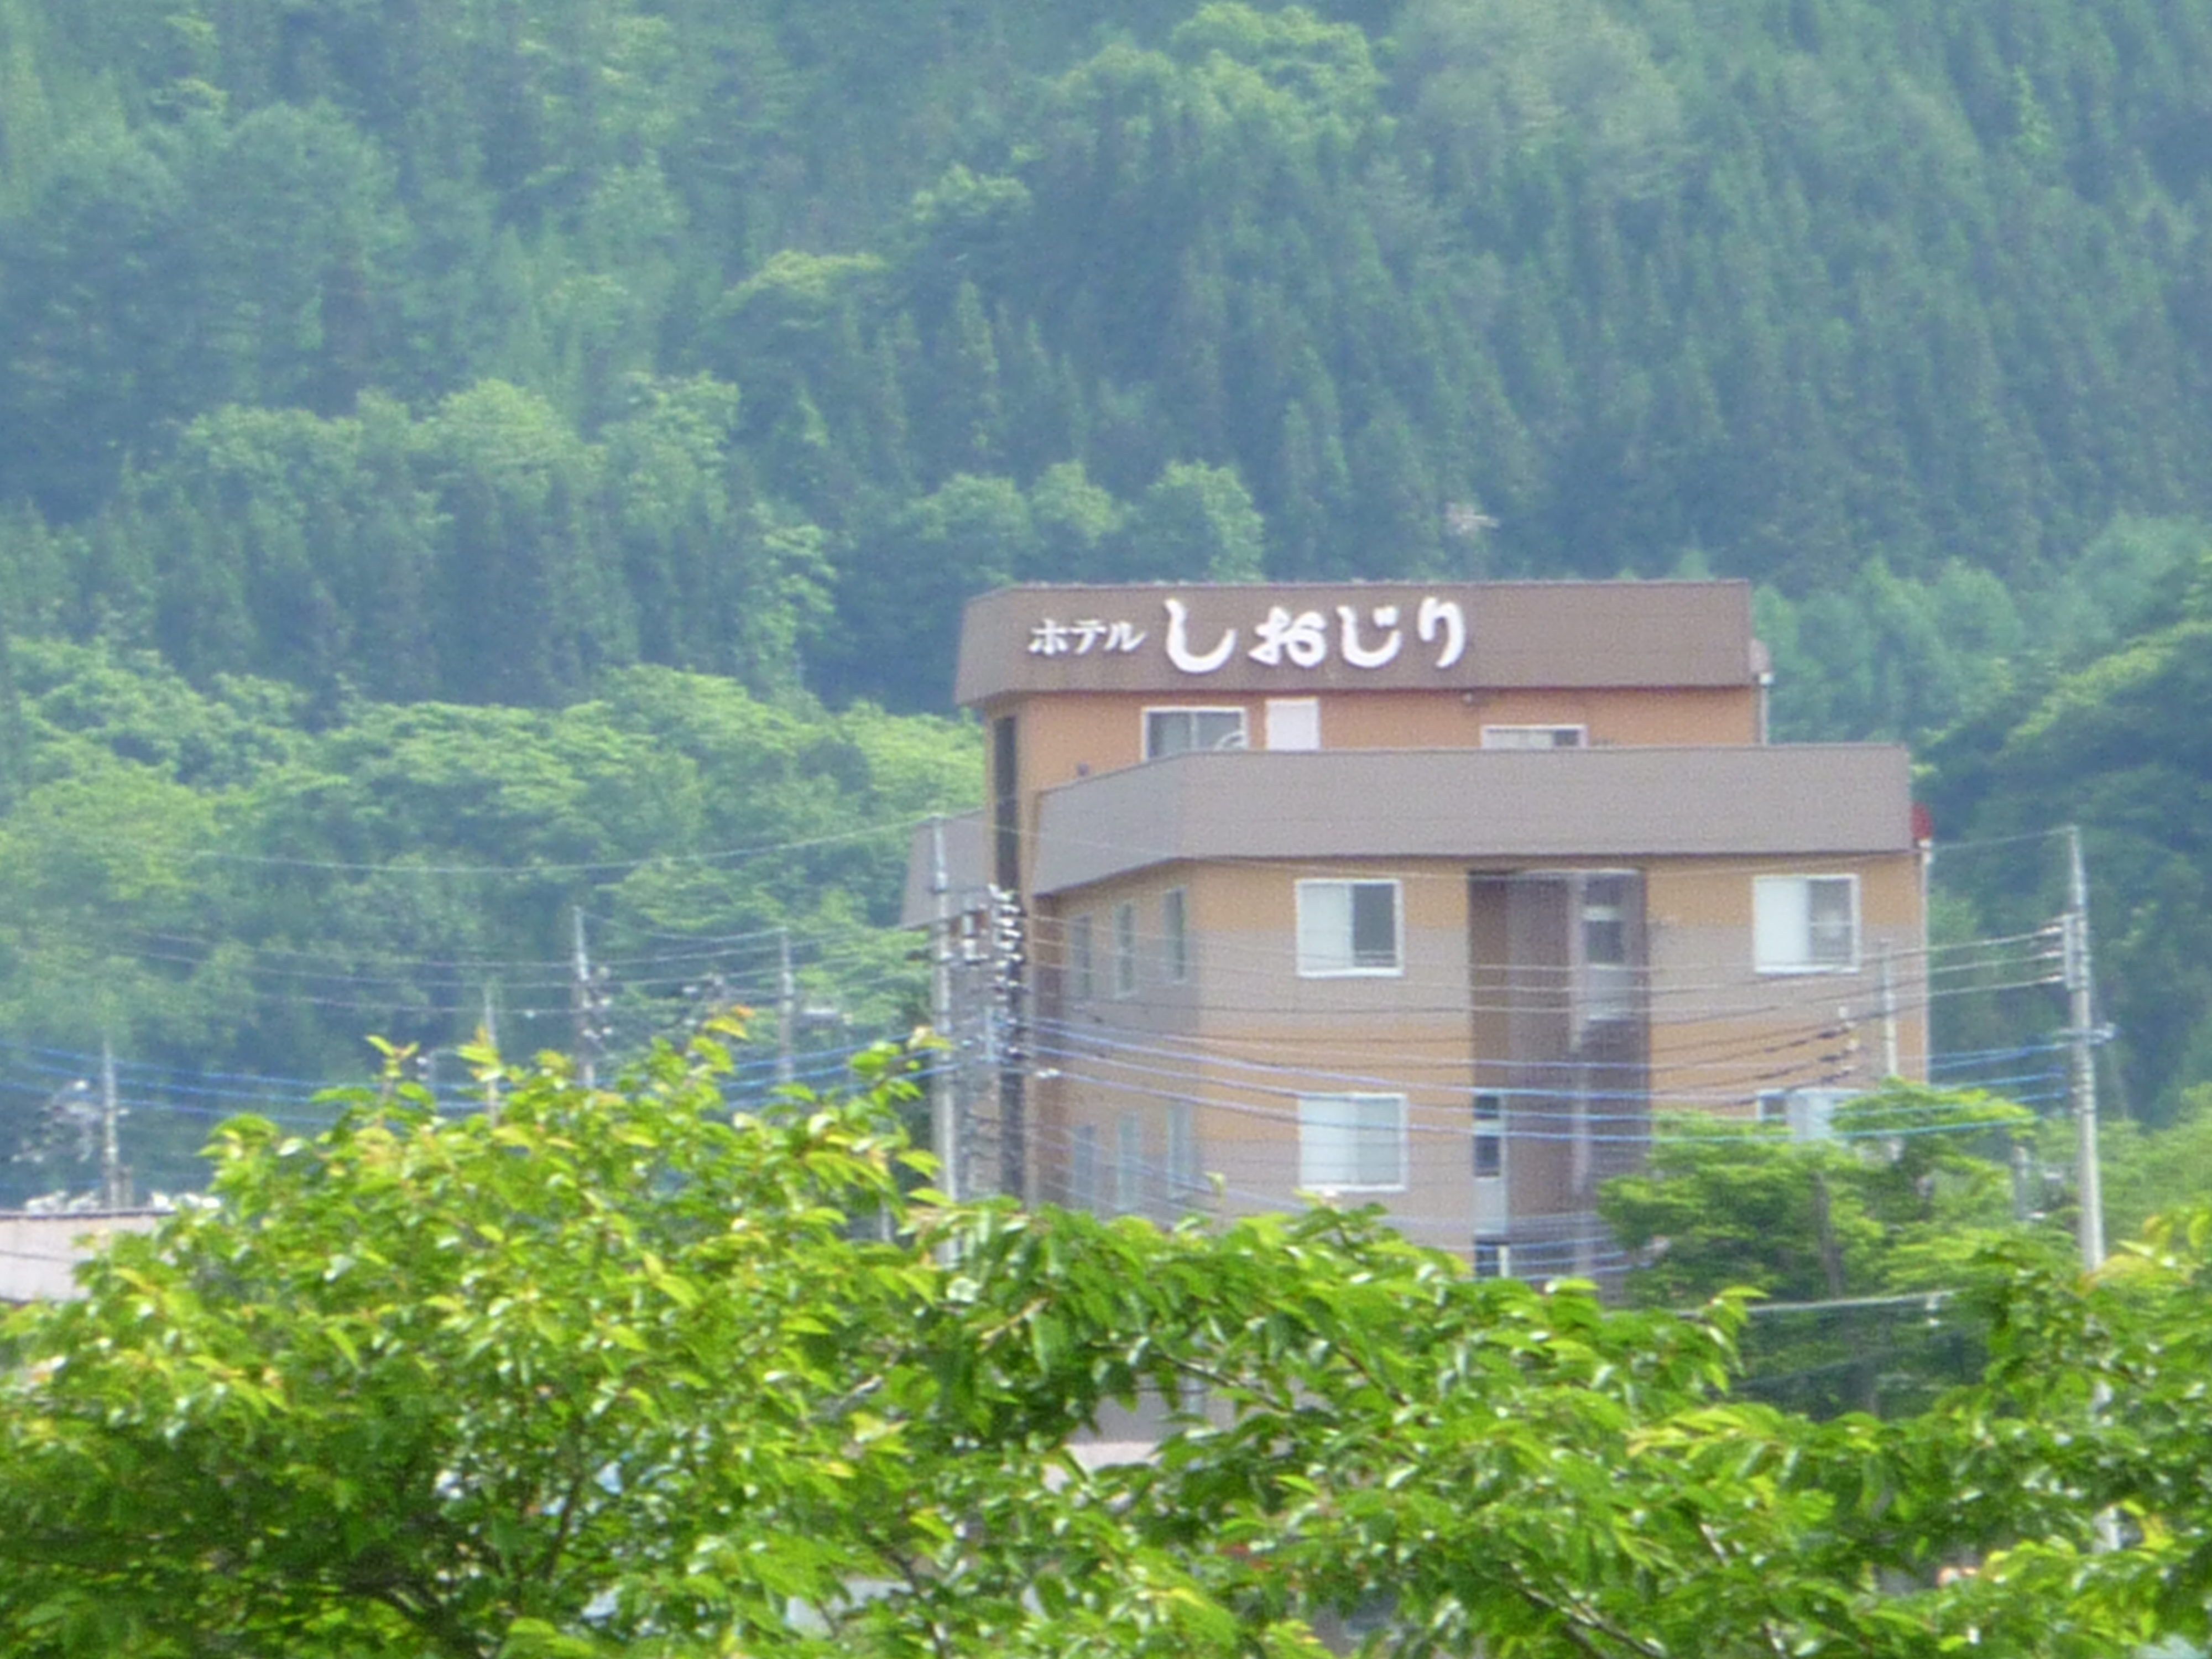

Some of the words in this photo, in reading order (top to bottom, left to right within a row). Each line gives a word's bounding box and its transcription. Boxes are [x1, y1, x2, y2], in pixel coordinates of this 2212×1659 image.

[1027, 618, 1147, 655] ホテル
[1163, 595, 1467, 674] しおじり
